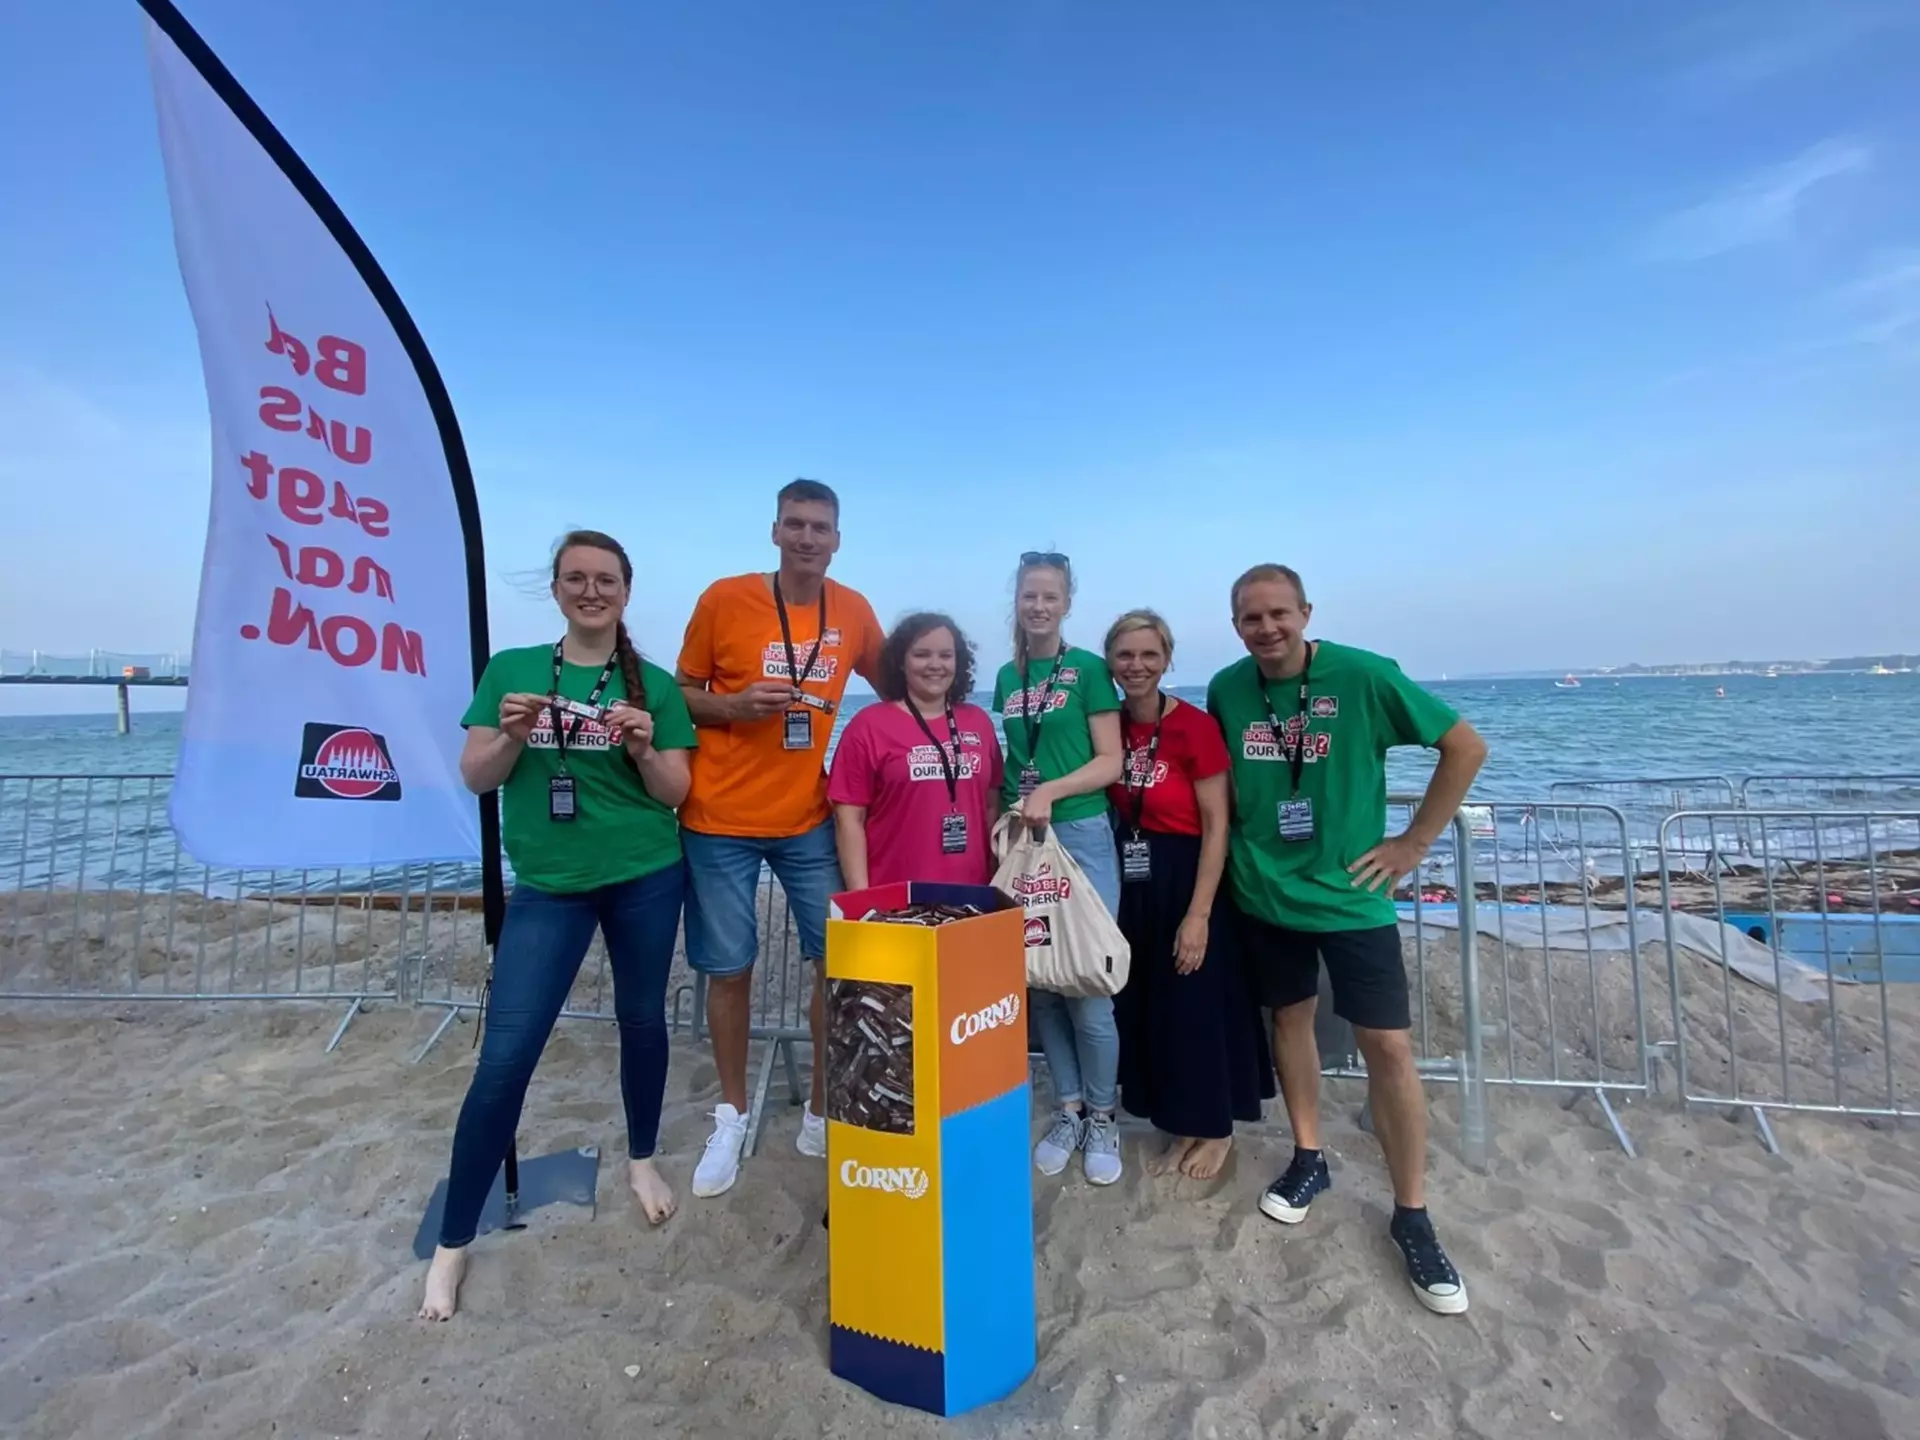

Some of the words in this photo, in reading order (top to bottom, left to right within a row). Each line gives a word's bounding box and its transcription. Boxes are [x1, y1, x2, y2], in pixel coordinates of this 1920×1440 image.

[1246, 745, 1275, 756] OUR
[912, 765, 938, 777] OUR
[951, 994, 1015, 1045] CORNY
[840, 1159, 919, 1193] CORNY
